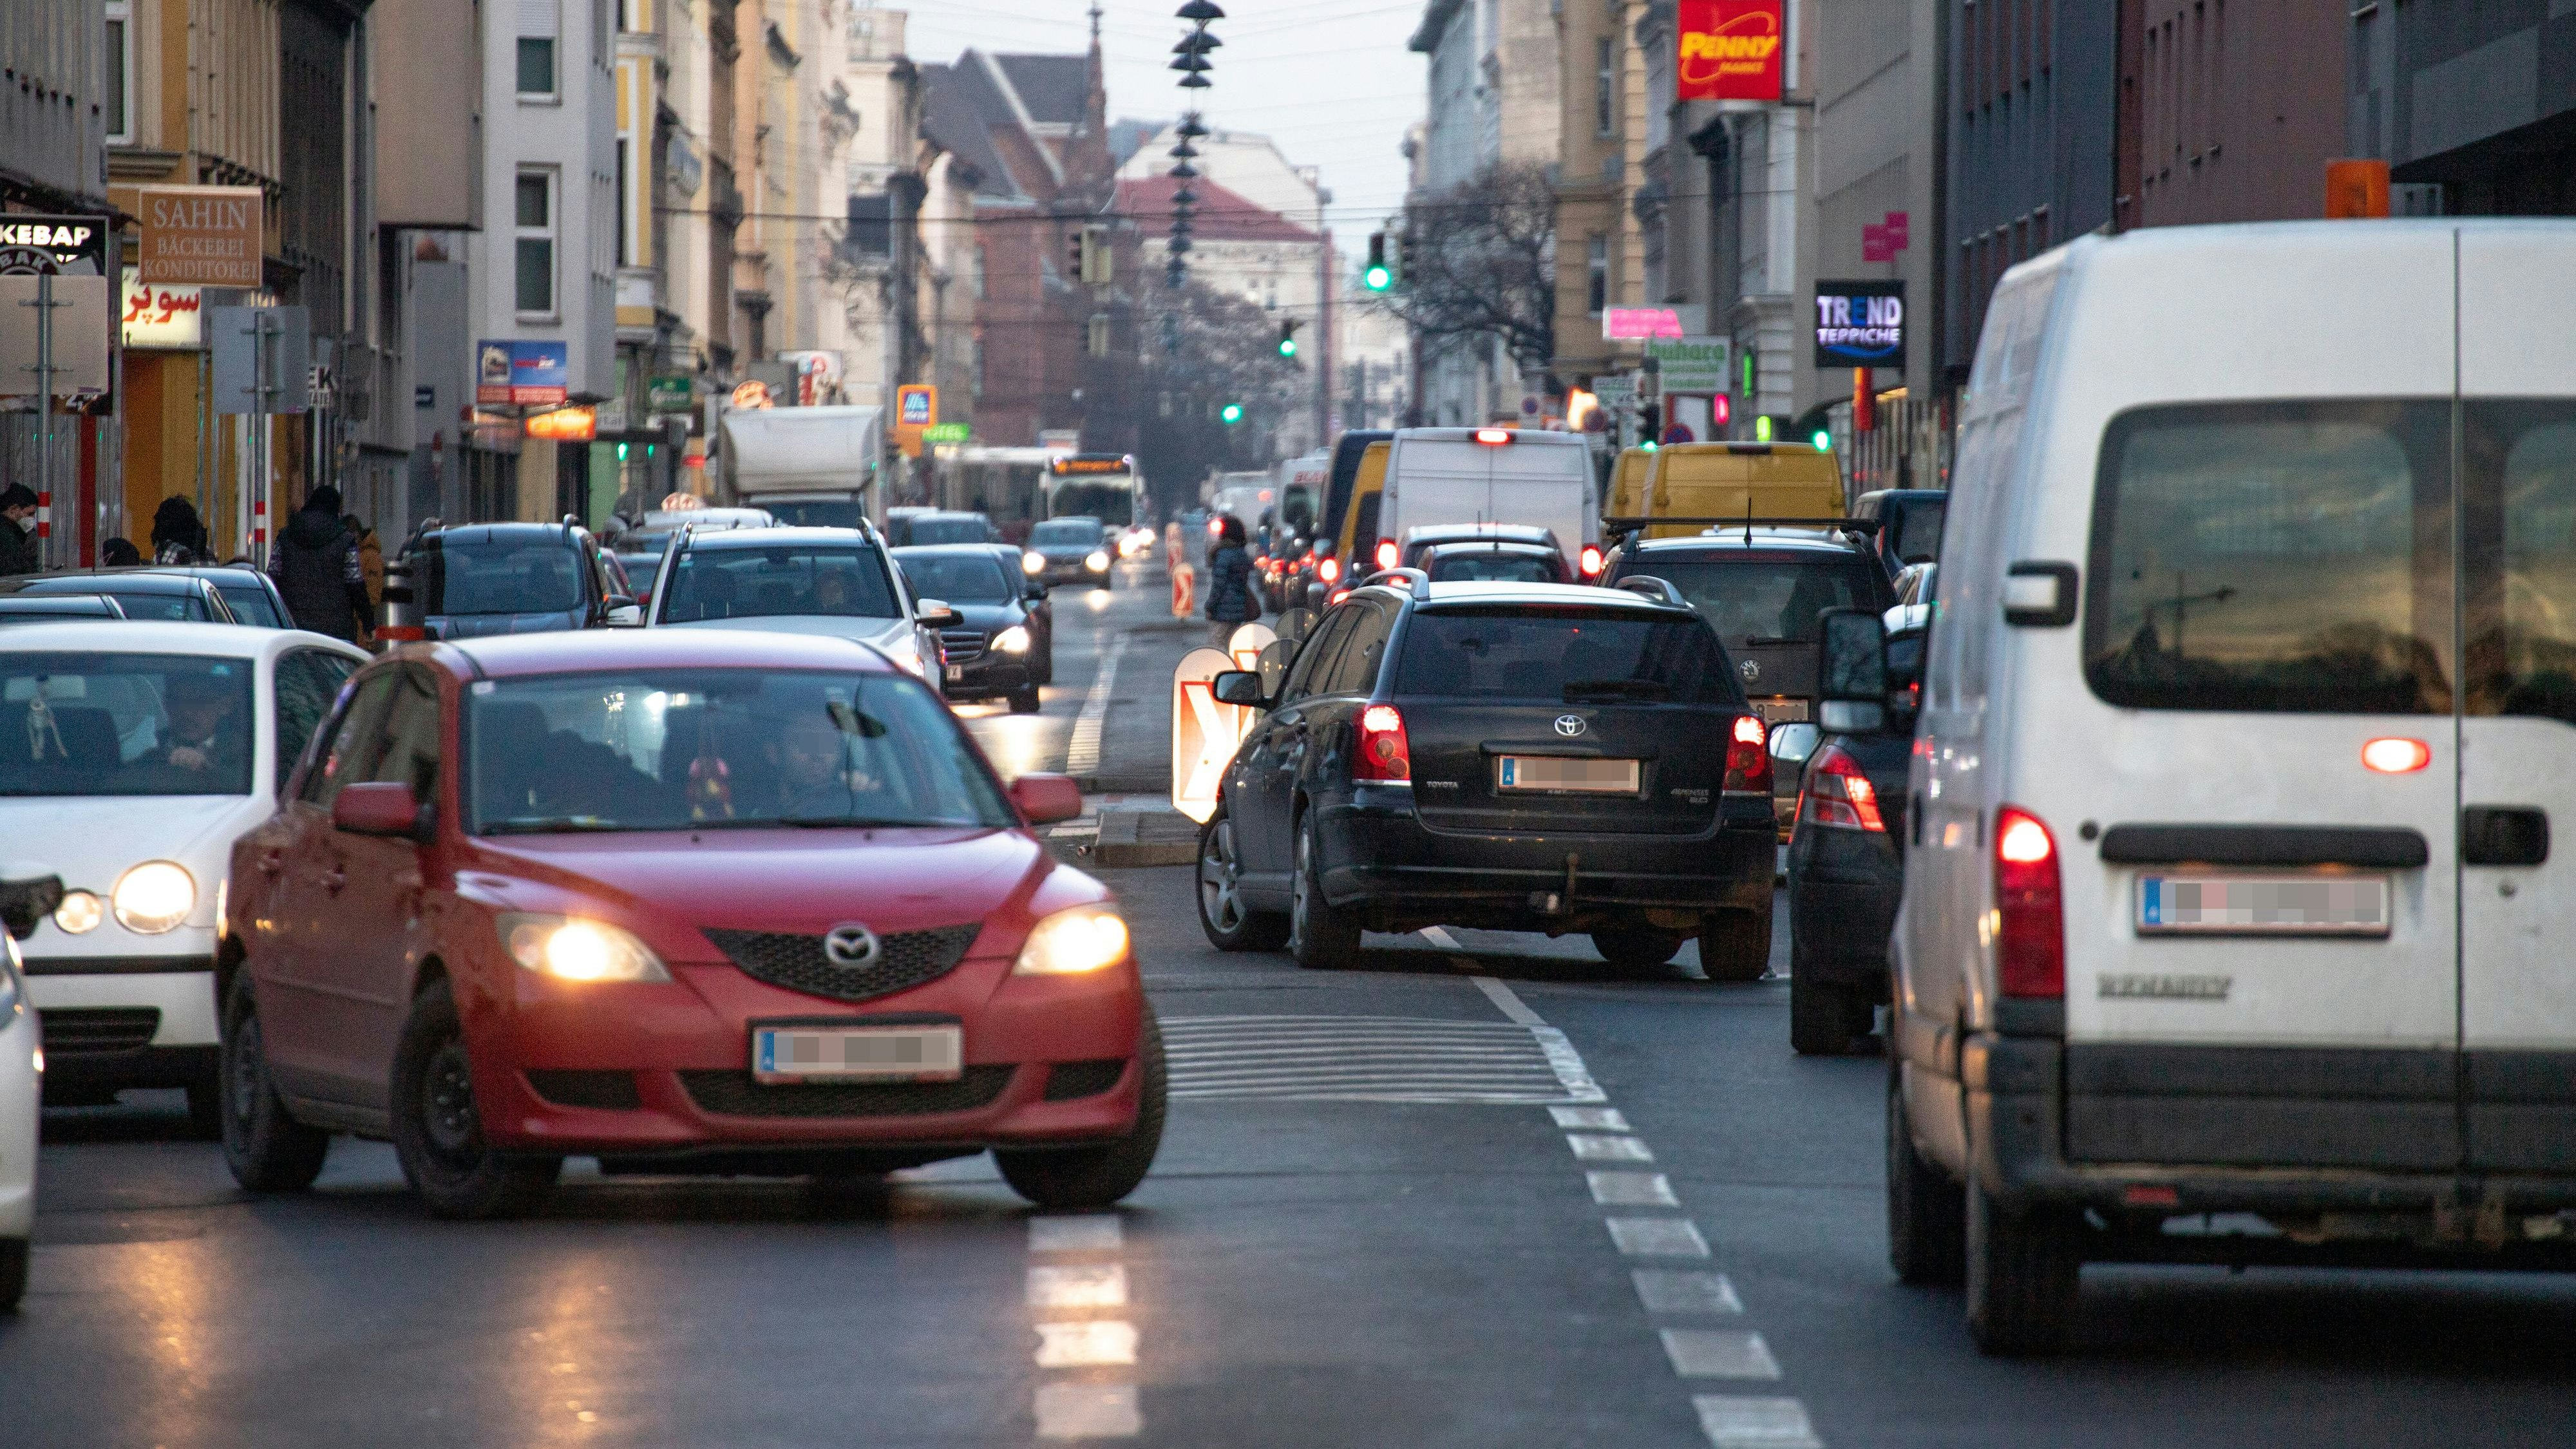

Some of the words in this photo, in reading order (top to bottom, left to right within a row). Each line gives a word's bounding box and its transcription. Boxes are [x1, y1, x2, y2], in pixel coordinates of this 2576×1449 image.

[1681, 32, 1777, 58] PENNY
[153, 198, 247, 229] SAHIN
[0, 224, 91, 246] KEBAP
[144, 259, 256, 280] KONDITOREI
[1817, 296, 1902, 327] TREND
[1817, 328, 1900, 346] TEPPICHE
